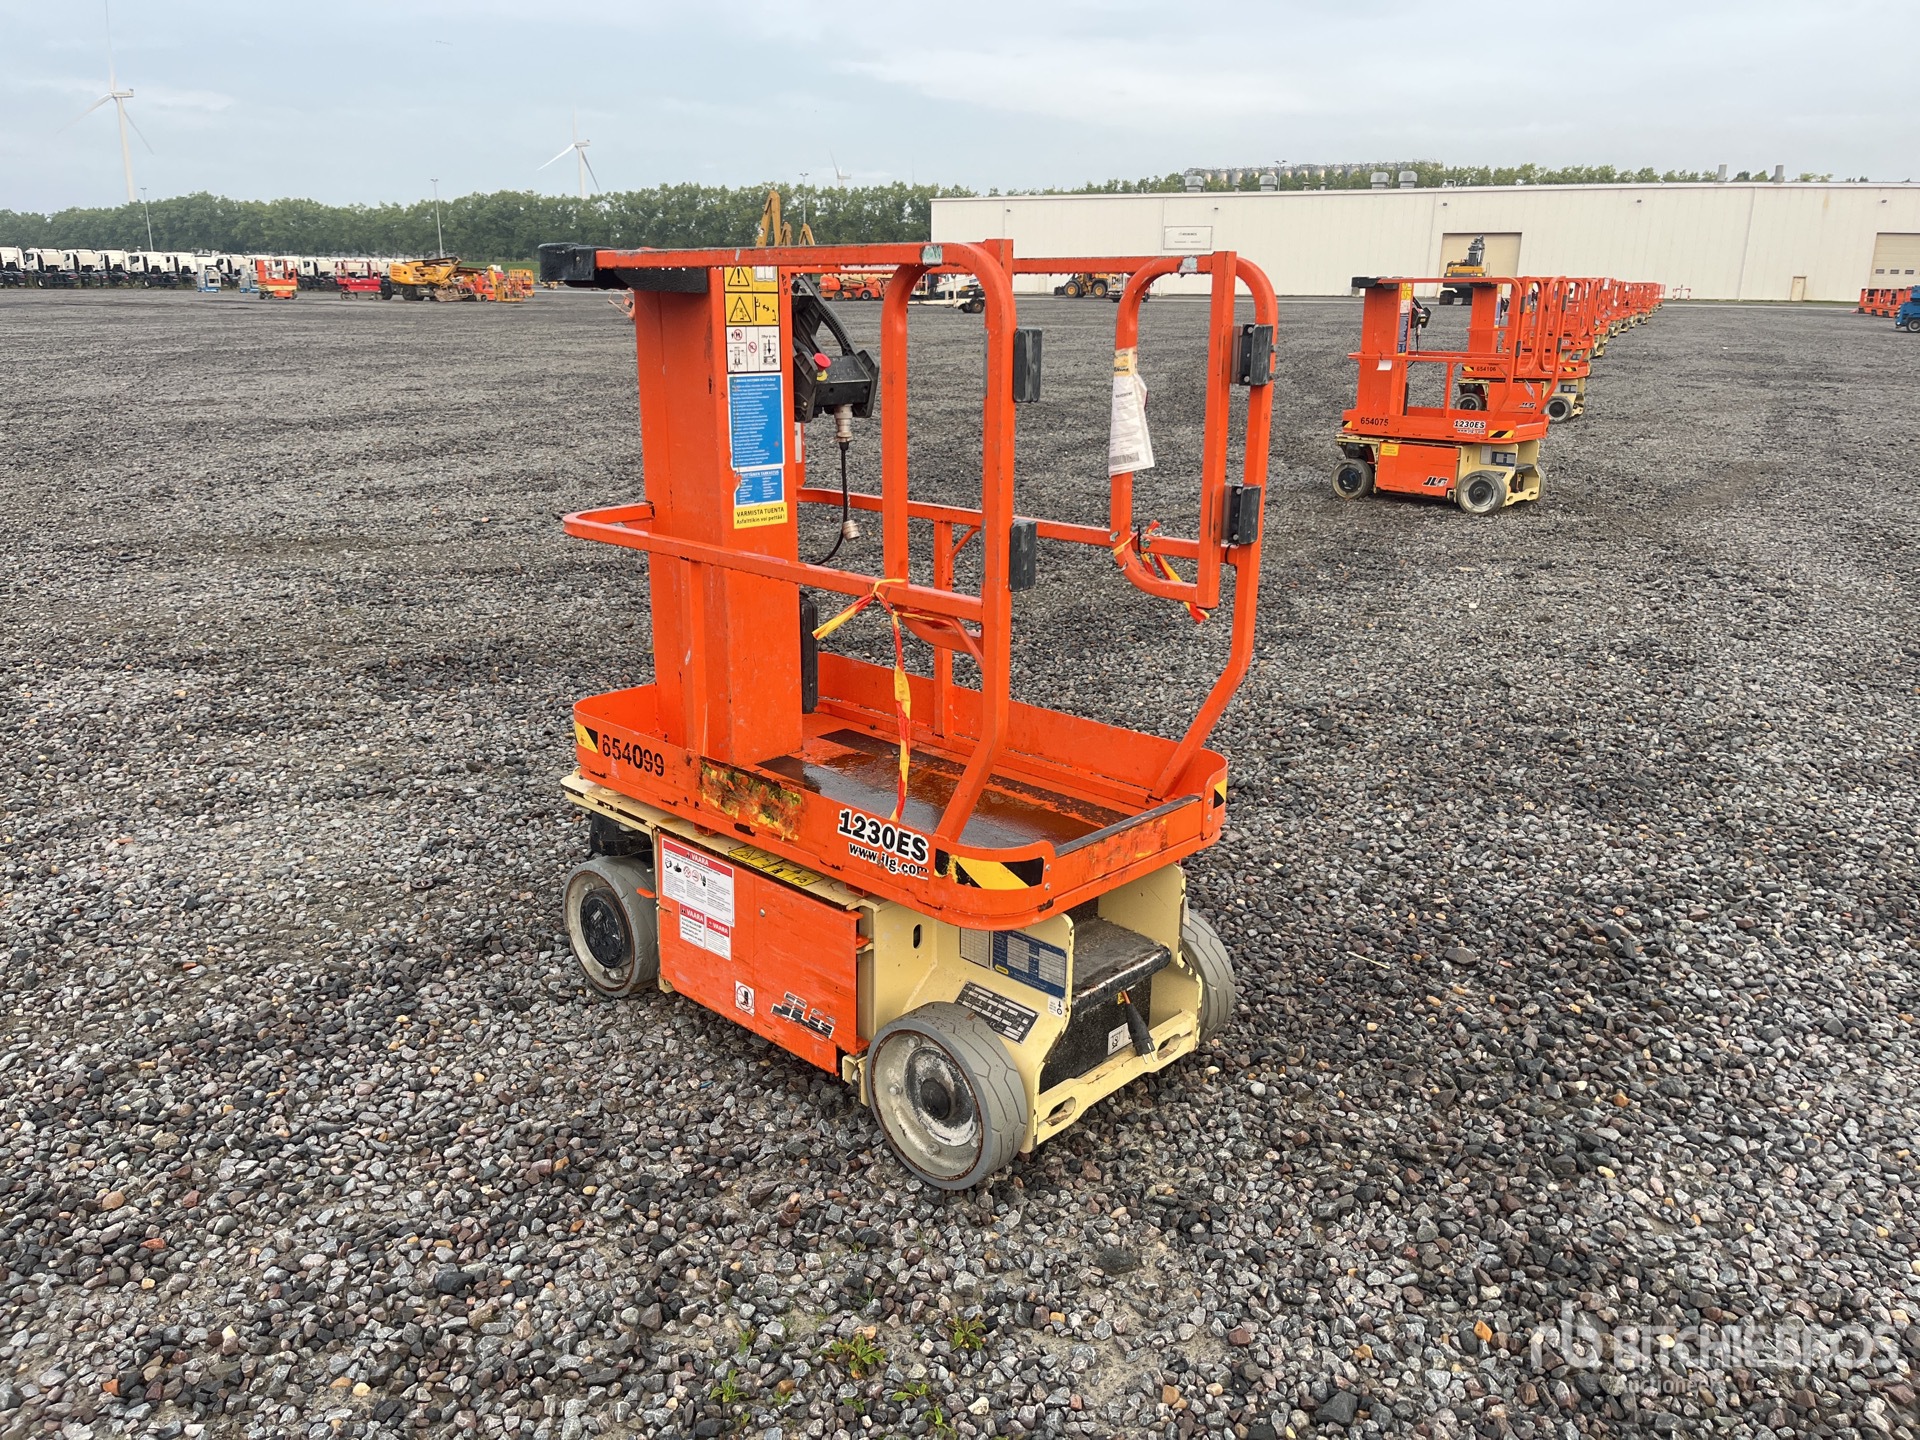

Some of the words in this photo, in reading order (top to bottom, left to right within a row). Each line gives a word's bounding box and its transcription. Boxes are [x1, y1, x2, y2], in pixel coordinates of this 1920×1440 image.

[1361, 417, 1389, 426] 654075
[1453, 420, 1486, 429] 1230ES
[1422, 476, 1448, 487] JLG
[736, 509, 763, 517] VARMISTA
[602, 734, 665, 777] 654099
[837, 808, 929, 864] 1230ES
[691, 853, 710, 867] VAARA
[686, 909, 704, 922] VAARA
